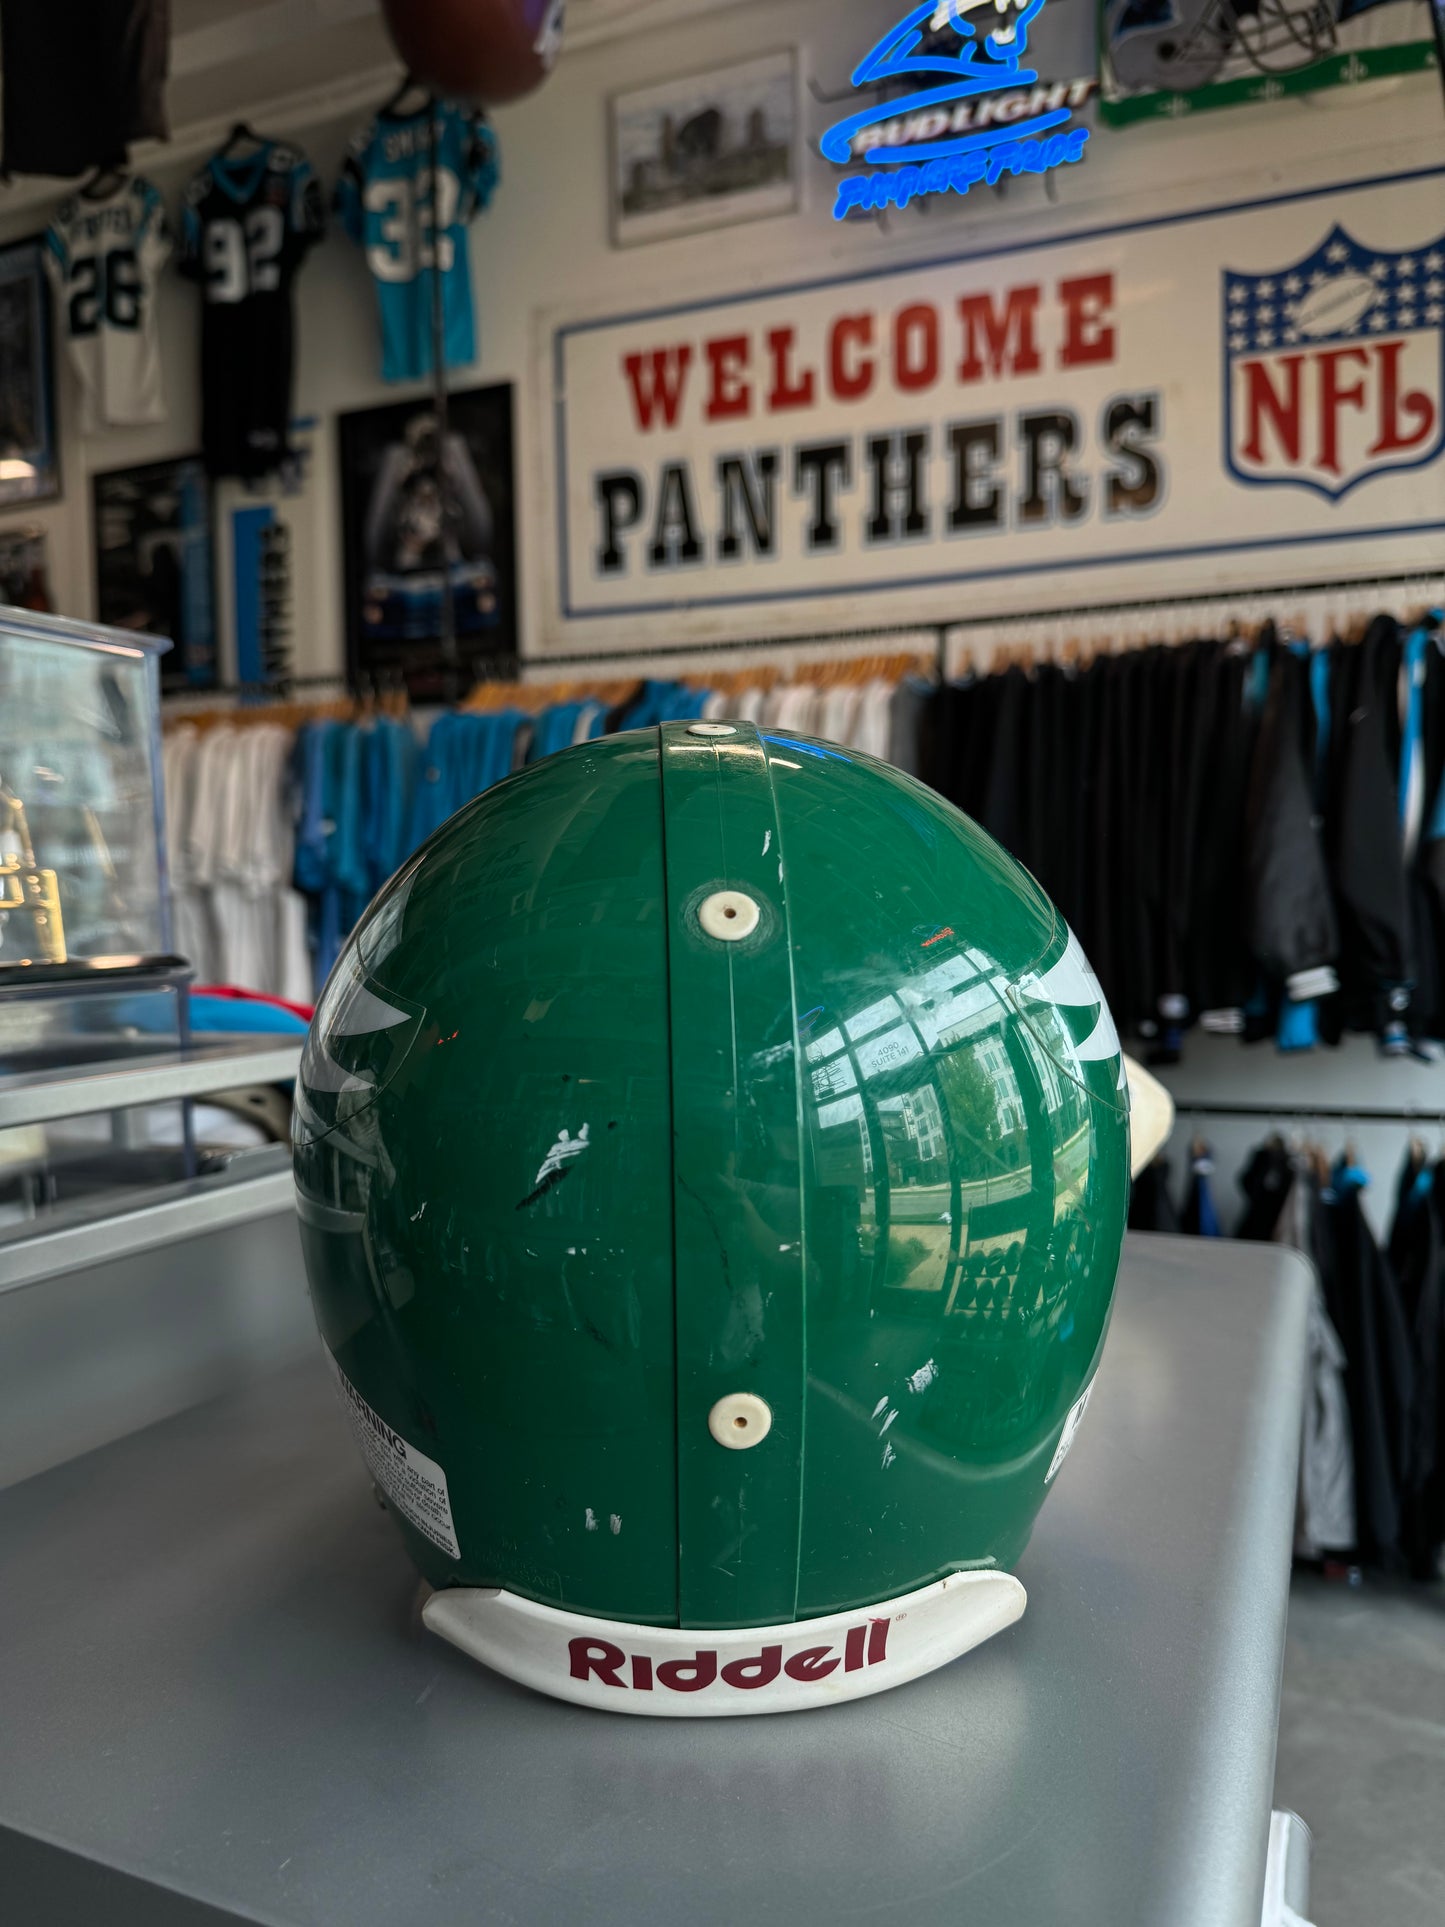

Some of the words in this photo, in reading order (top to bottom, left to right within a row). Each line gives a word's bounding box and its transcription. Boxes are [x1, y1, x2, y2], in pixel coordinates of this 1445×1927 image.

[949, 78, 1098, 131] LIGHT
[68, 247, 143, 338] 26
[205, 205, 286, 303] 92
[622, 271, 1118, 433] WELCOME
[1241, 339, 1436, 475] NFL
[593, 390, 1166, 577] PANTHERS
[871, 1052, 897, 1068] SUITE
[878, 1041, 899, 1056] 4090
[568, 1617, 891, 1692] Riddell
